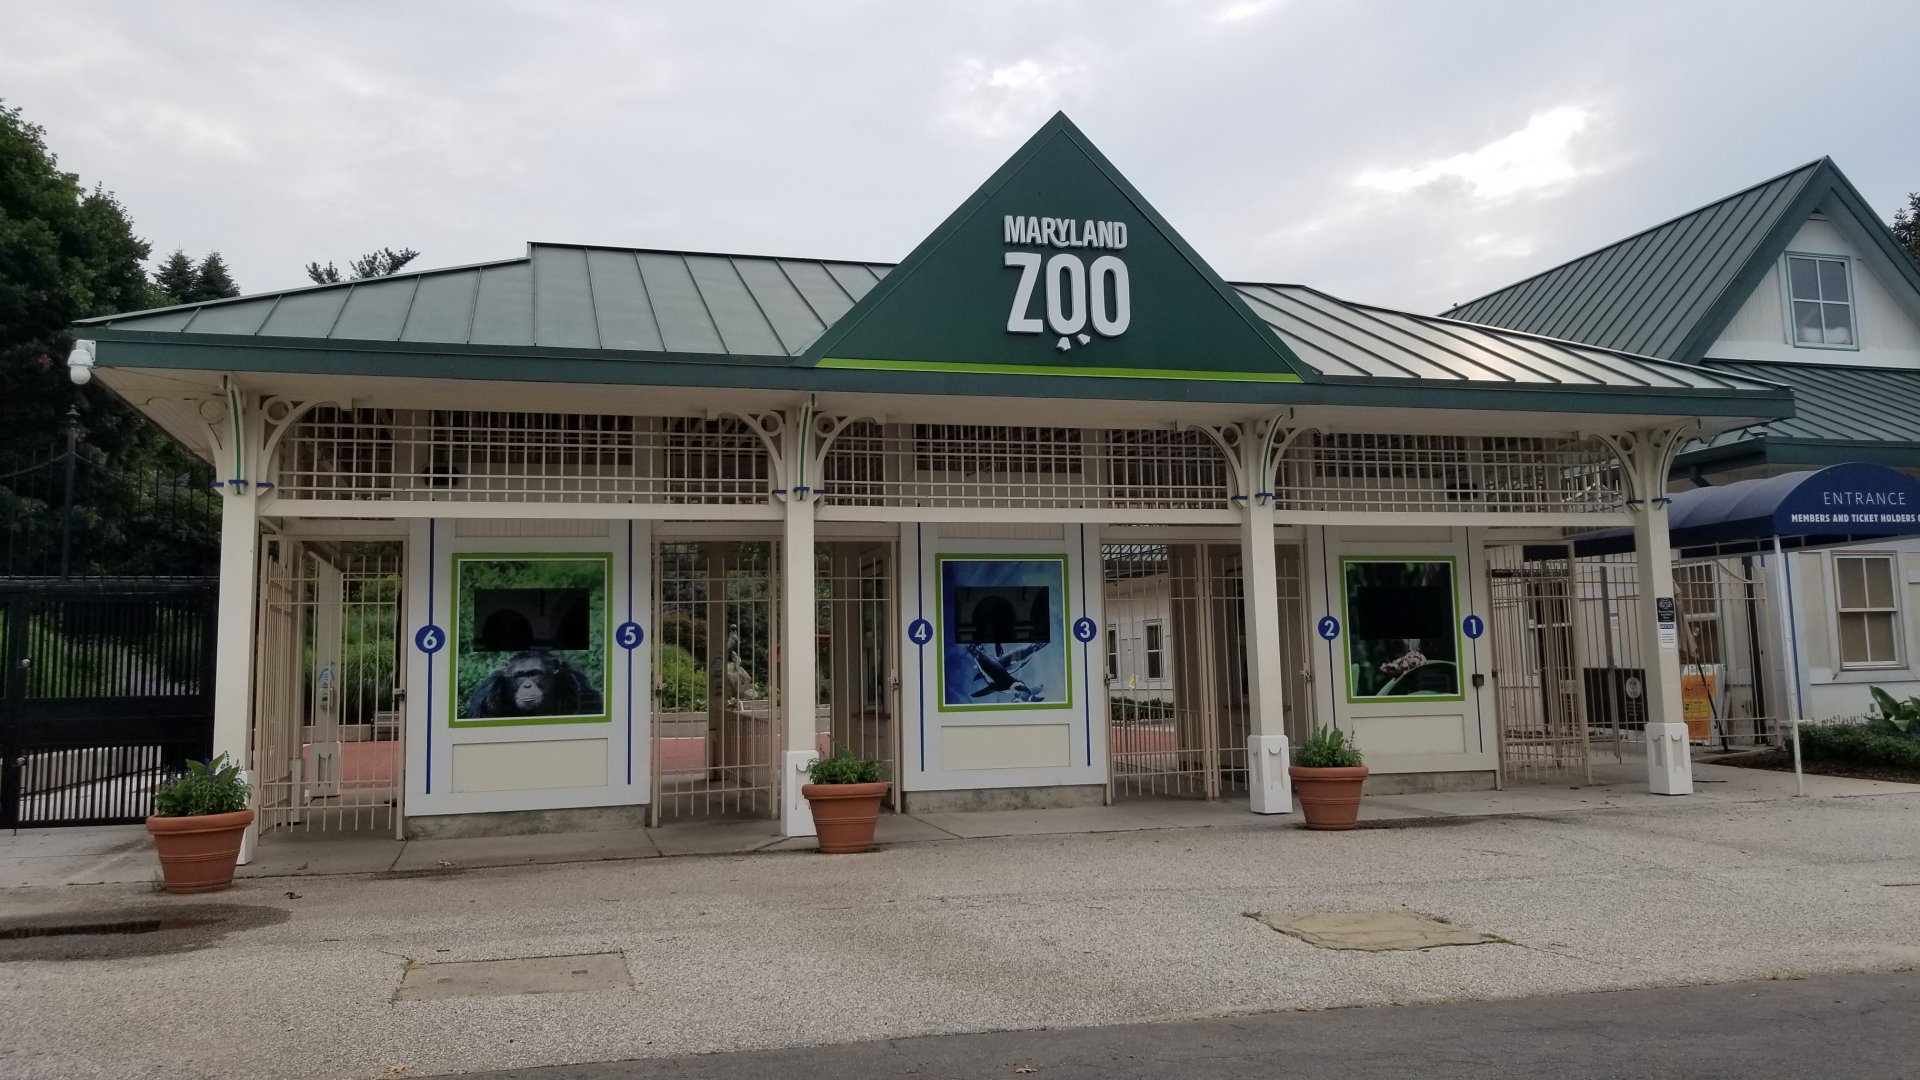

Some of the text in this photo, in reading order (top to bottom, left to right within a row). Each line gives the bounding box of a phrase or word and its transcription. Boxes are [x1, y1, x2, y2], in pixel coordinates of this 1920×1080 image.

[1004, 215, 1128, 249] MARYLAND
[1004, 252, 1131, 337] ZOO
[1823, 492, 1906, 505] ENTRANCE
[1791, 513, 1830, 523] MEMBERS
[1832, 513, 1849, 523] AND
[1851, 514, 1878, 523] TICKET
[1880, 514, 1915, 522] HOLDERS
[623, 626, 637, 645] 5
[914, 623, 927, 641] 4
[1079, 621, 1091, 638] 3
[1324, 619, 1335, 636] 2
[1470, 619, 1477, 635] 1
[423, 629, 438, 649] 6
